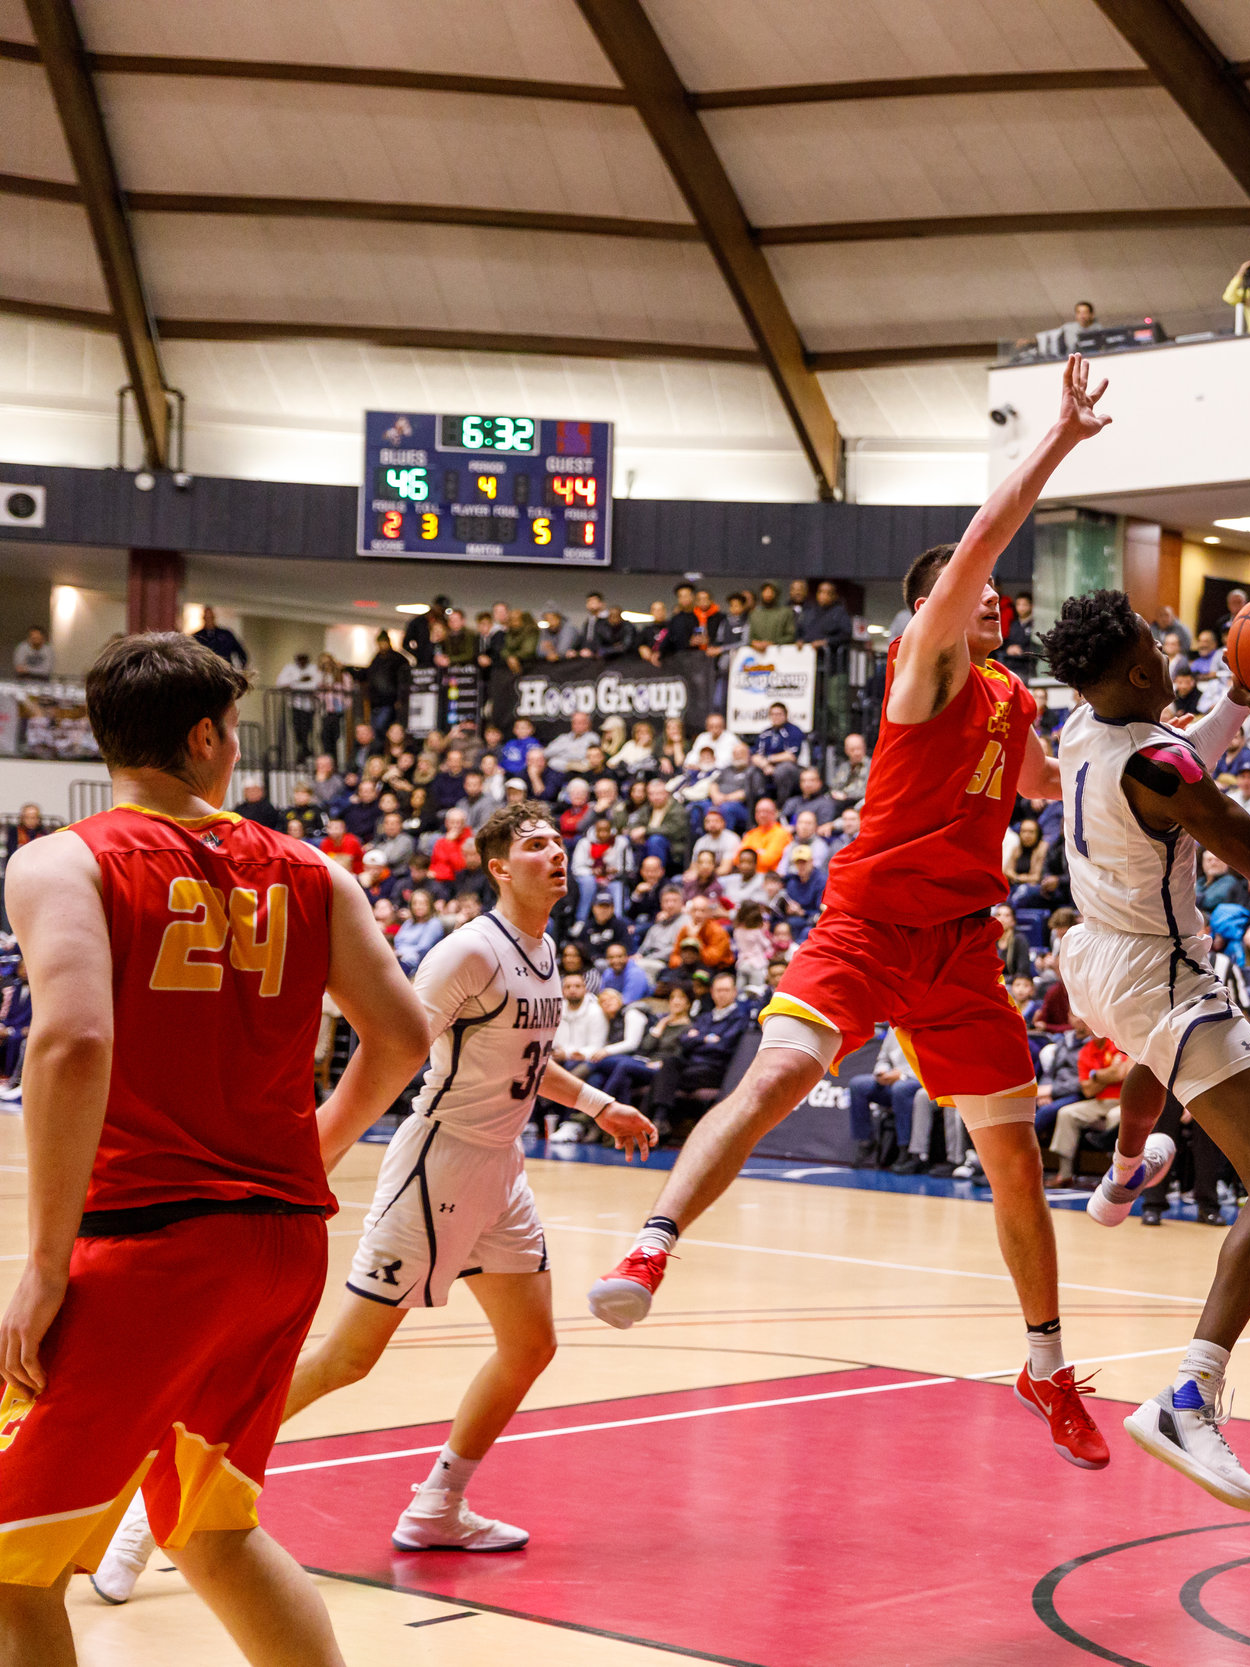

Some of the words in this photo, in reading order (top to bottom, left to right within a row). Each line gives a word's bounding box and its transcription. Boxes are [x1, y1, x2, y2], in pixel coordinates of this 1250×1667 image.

[462, 416, 535, 451] 6:32
[380, 448, 427, 466] BLUES
[546, 456, 595, 474] GUEST
[386, 468, 428, 501] 46
[478, 476, 497, 499] 4
[553, 476, 596, 507] 44
[383, 511, 402, 539] 2
[422, 513, 438, 540] 3
[584, 521, 595, 545] 1
[1073, 761, 1089, 858] 1
[149, 877, 288, 997] 24
[512, 997, 563, 1029] RANNE
